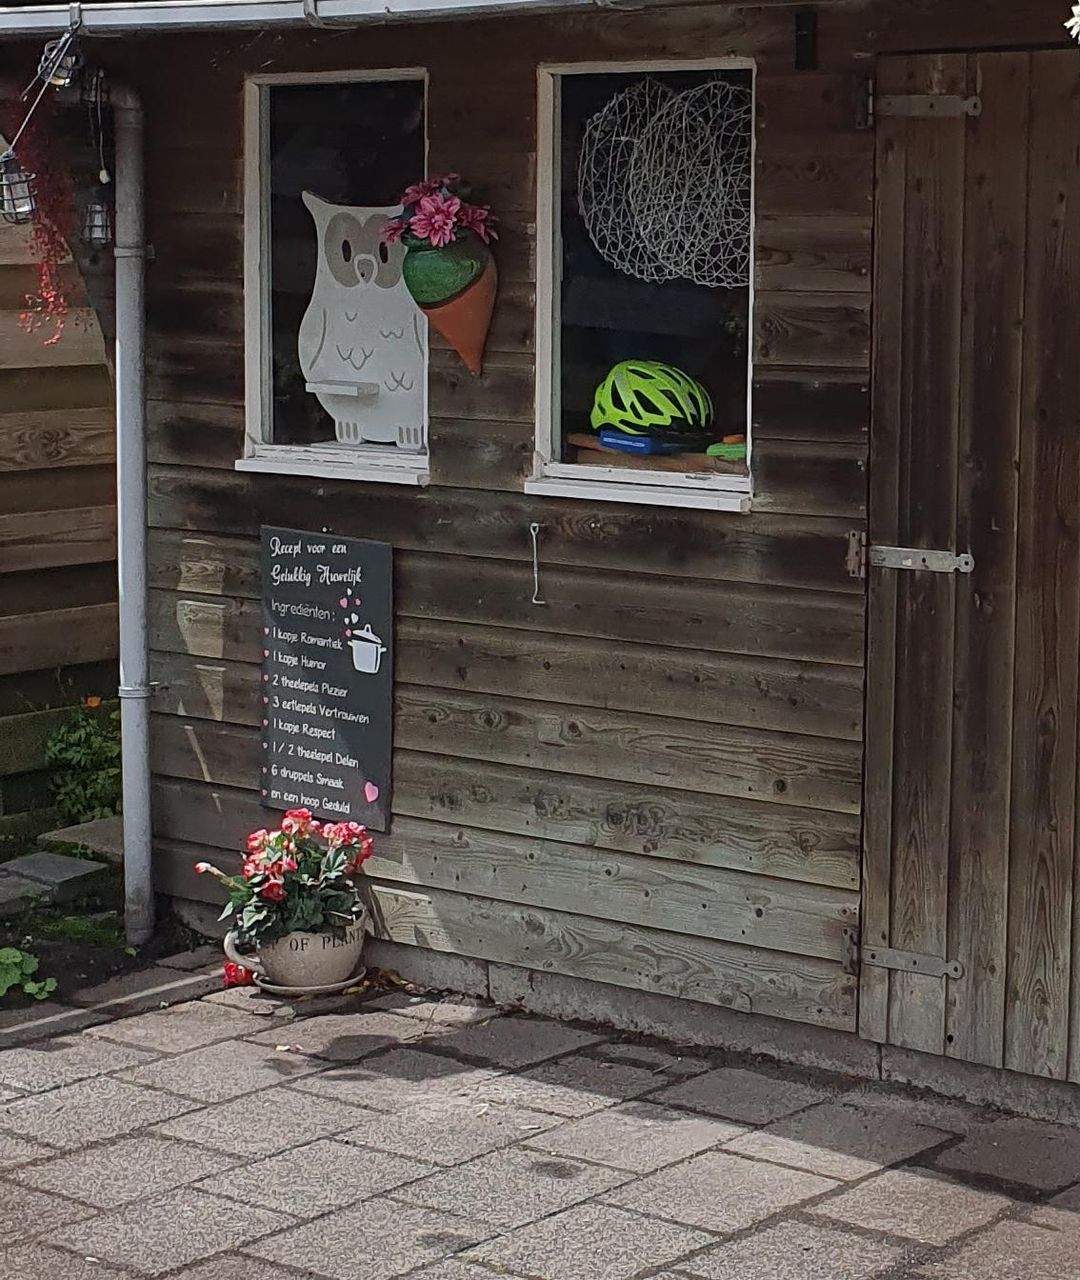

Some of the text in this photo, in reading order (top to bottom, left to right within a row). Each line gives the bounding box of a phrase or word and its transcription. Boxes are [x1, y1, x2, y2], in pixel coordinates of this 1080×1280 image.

[270, 536, 347, 558] Recept voor een
[270, 564, 362, 587] Gelukkig Huwelijk
[278, 628, 298, 643] kopje
[301, 632, 343, 650] Romantiek
[278, 651, 299, 667] kopje
[301, 655, 327, 670] Humor
[272, 674, 348, 697] 2 theelepels Plezier
[272, 696, 370, 724] 3 eetlepels Vertrouwen
[278, 718, 300, 735] kopje
[302, 723, 336, 740] Respect
[297, 745, 333, 764] theelepel
[335, 752, 359, 769] Delen
[271, 764, 345, 790] 6 druppels Smaak
[271, 790, 351, 814] en een hoop Geduld
[289, 937, 309, 951] OF
